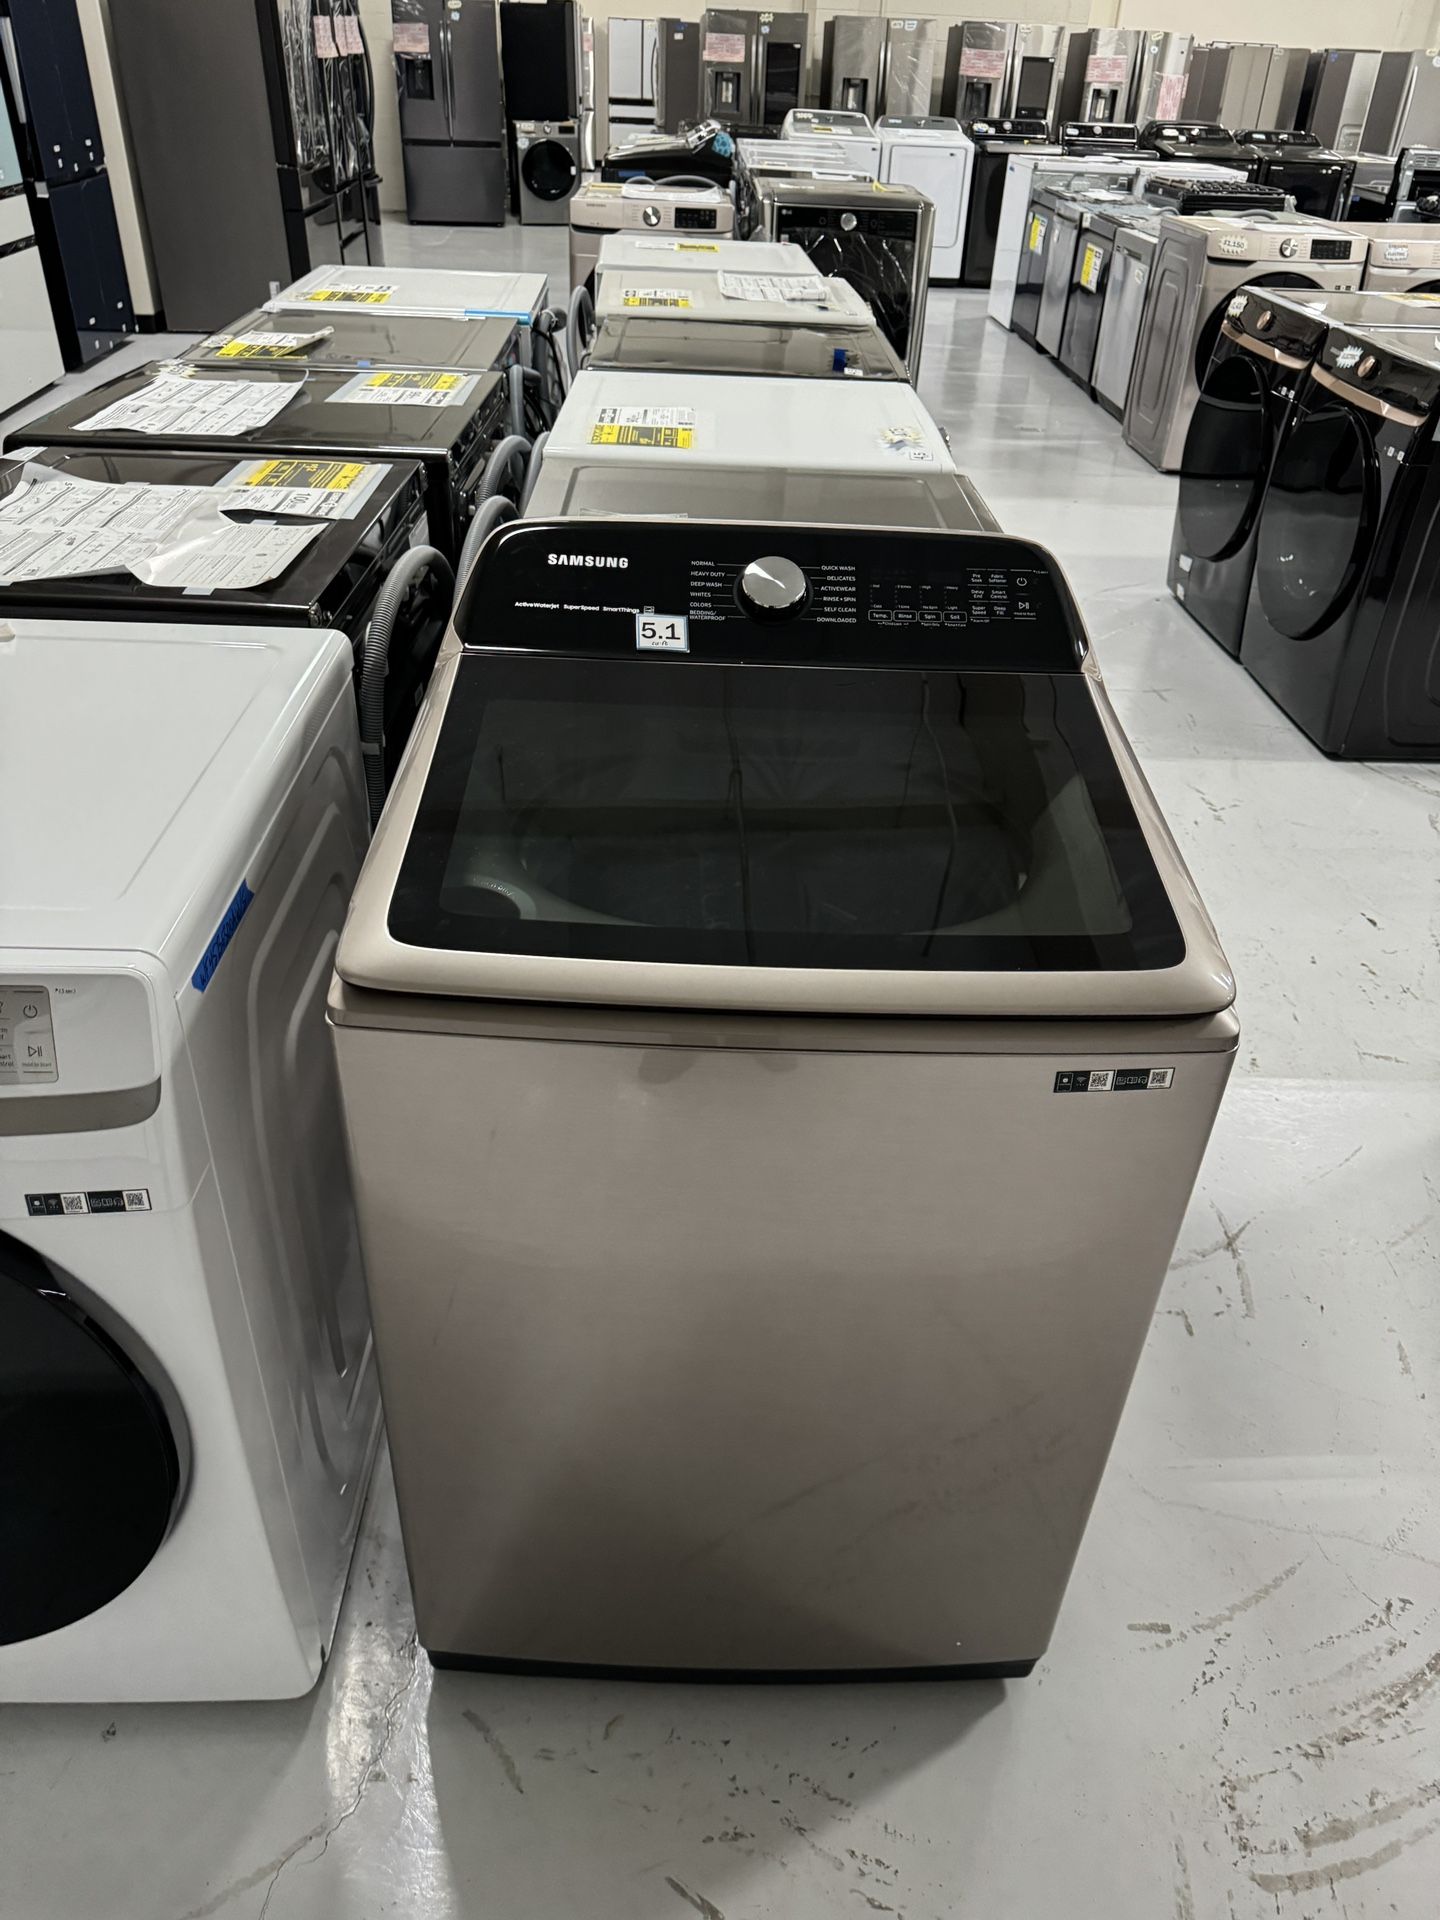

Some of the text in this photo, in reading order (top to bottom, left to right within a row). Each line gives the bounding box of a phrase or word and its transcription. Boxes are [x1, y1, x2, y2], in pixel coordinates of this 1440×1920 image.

[548, 554, 628, 568] SAMSUNG
[515, 601, 559, 609] ActiveWaterjet
[641, 622, 681, 640] 5.1
